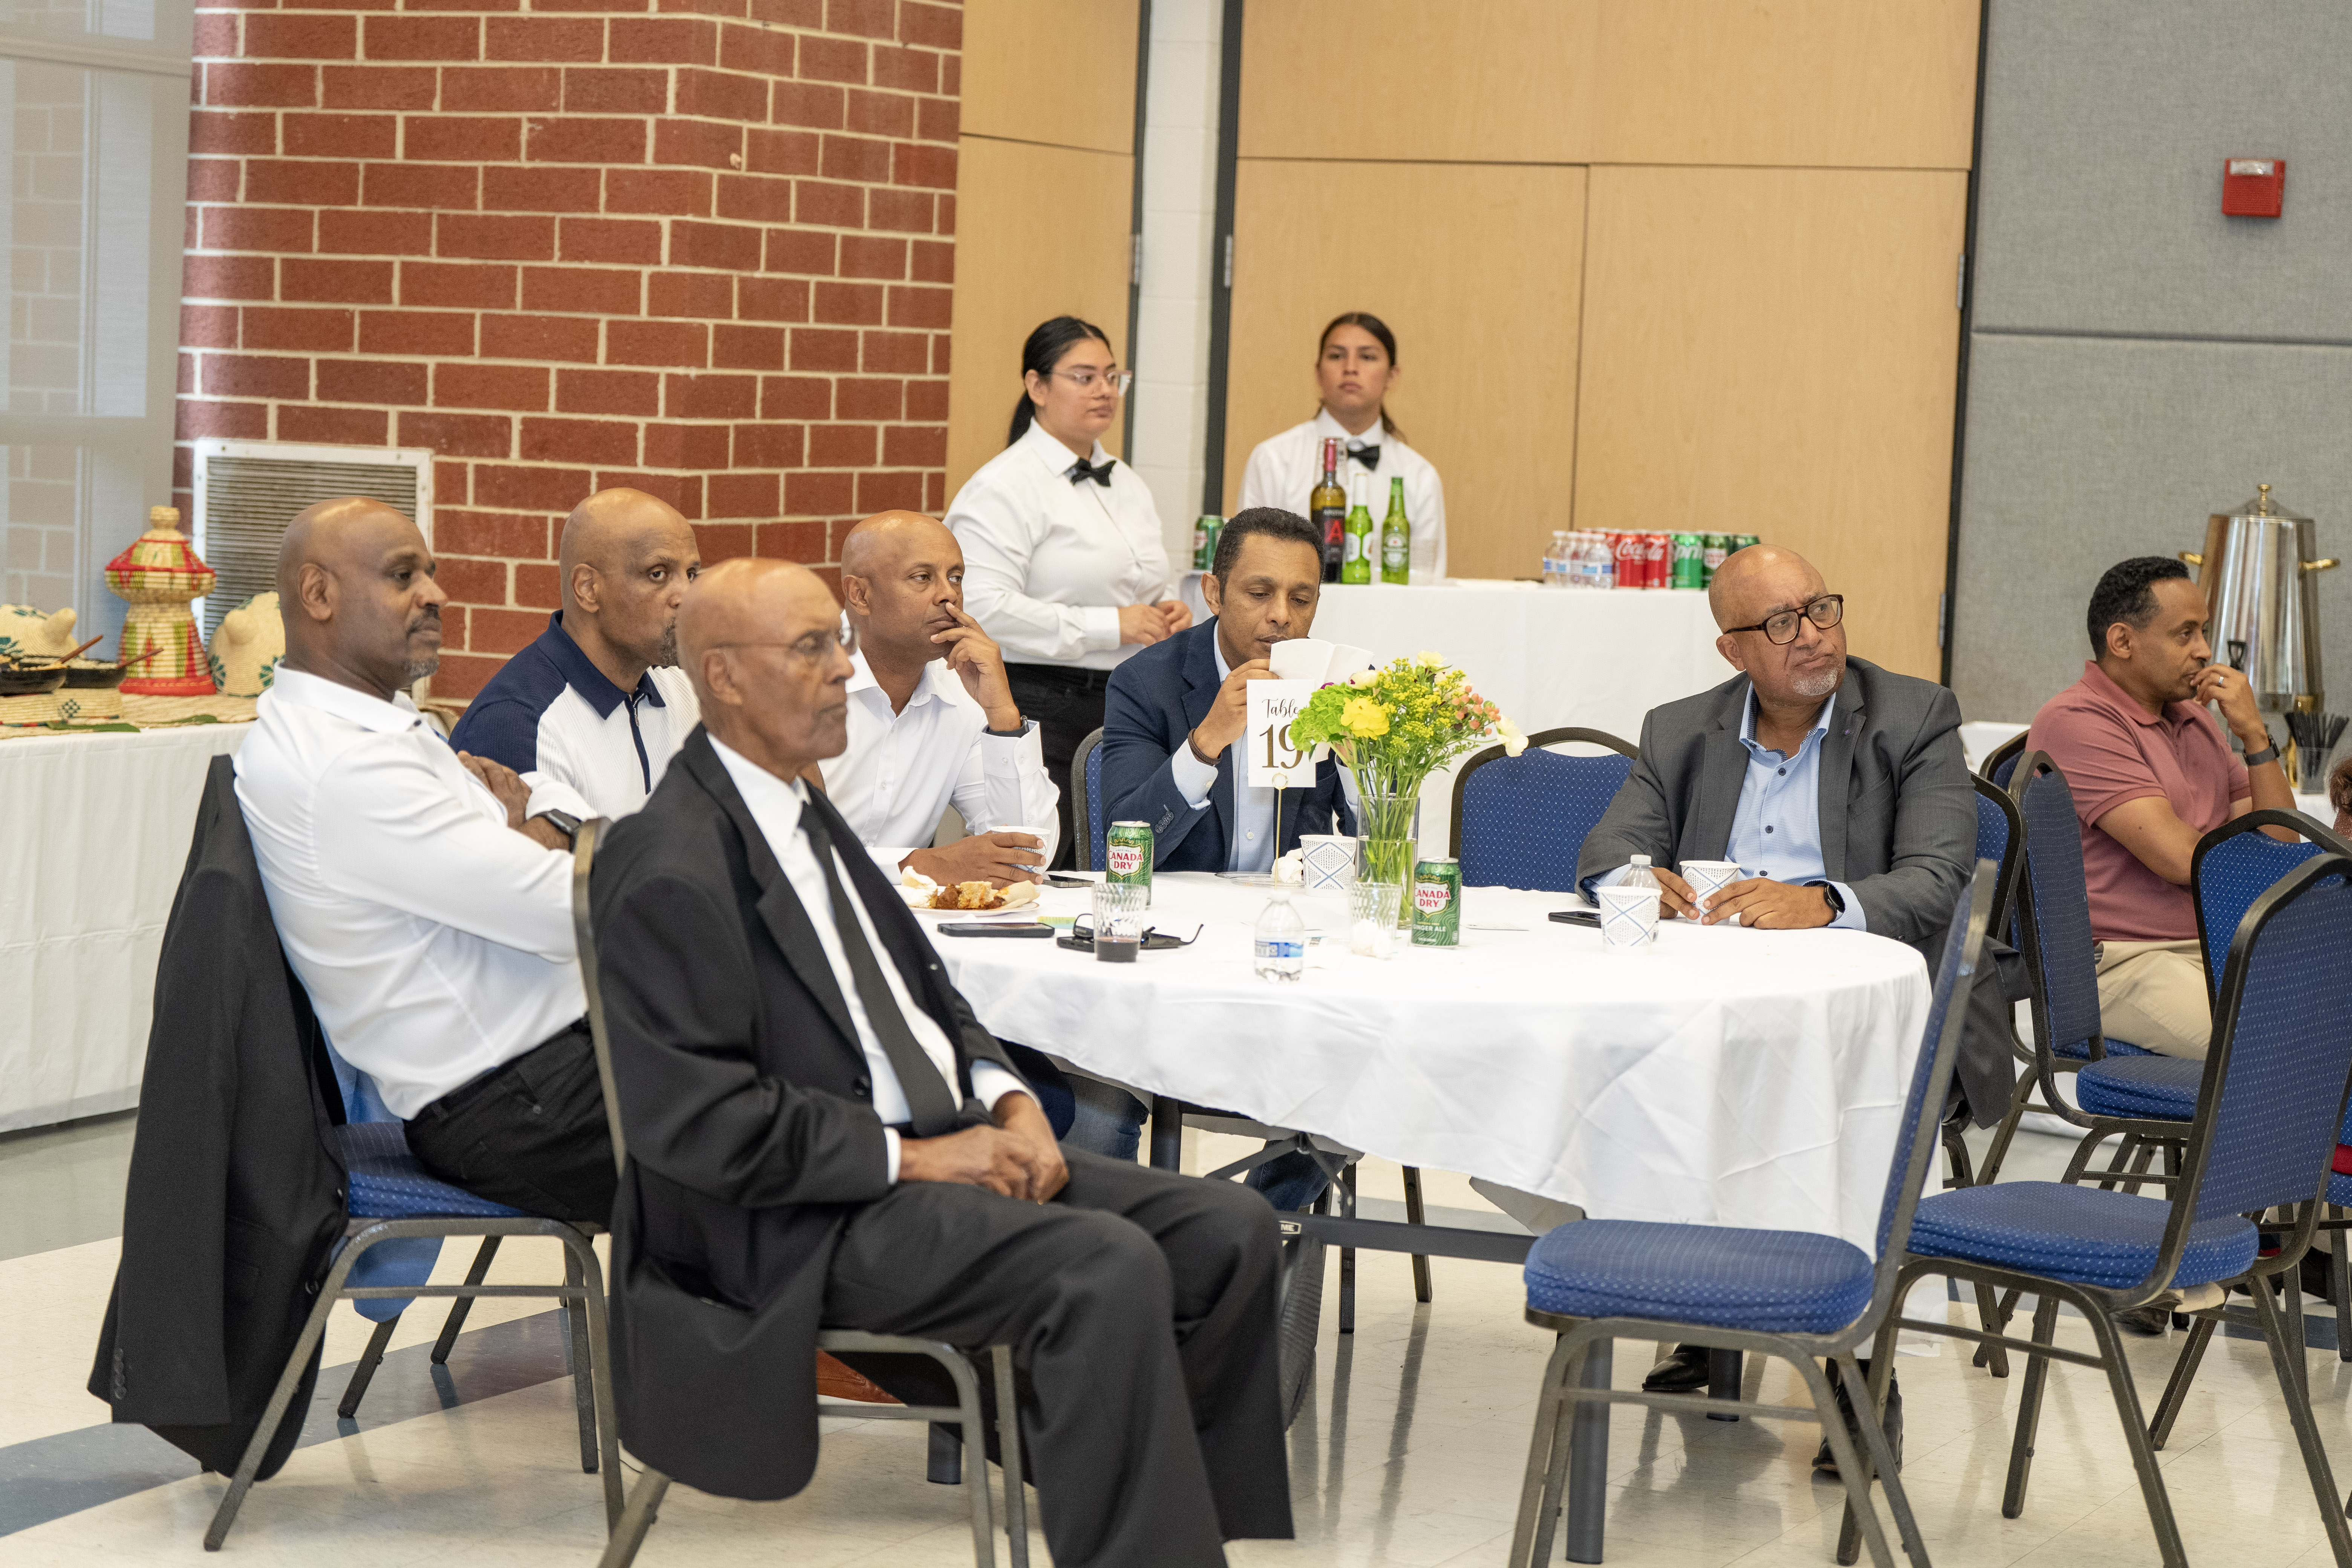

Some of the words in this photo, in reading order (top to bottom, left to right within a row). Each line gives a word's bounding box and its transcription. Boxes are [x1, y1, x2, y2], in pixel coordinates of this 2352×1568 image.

[1262, 699, 1299, 718] Table
[1259, 724, 1303, 769] 19
[1108, 851, 1143, 861] CANADA
[1114, 861, 1133, 869] DRY
[1414, 888, 1449, 899] CANADA
[1420, 899, 1439, 907] DRY
[1280, 1223, 1295, 1232] ME
